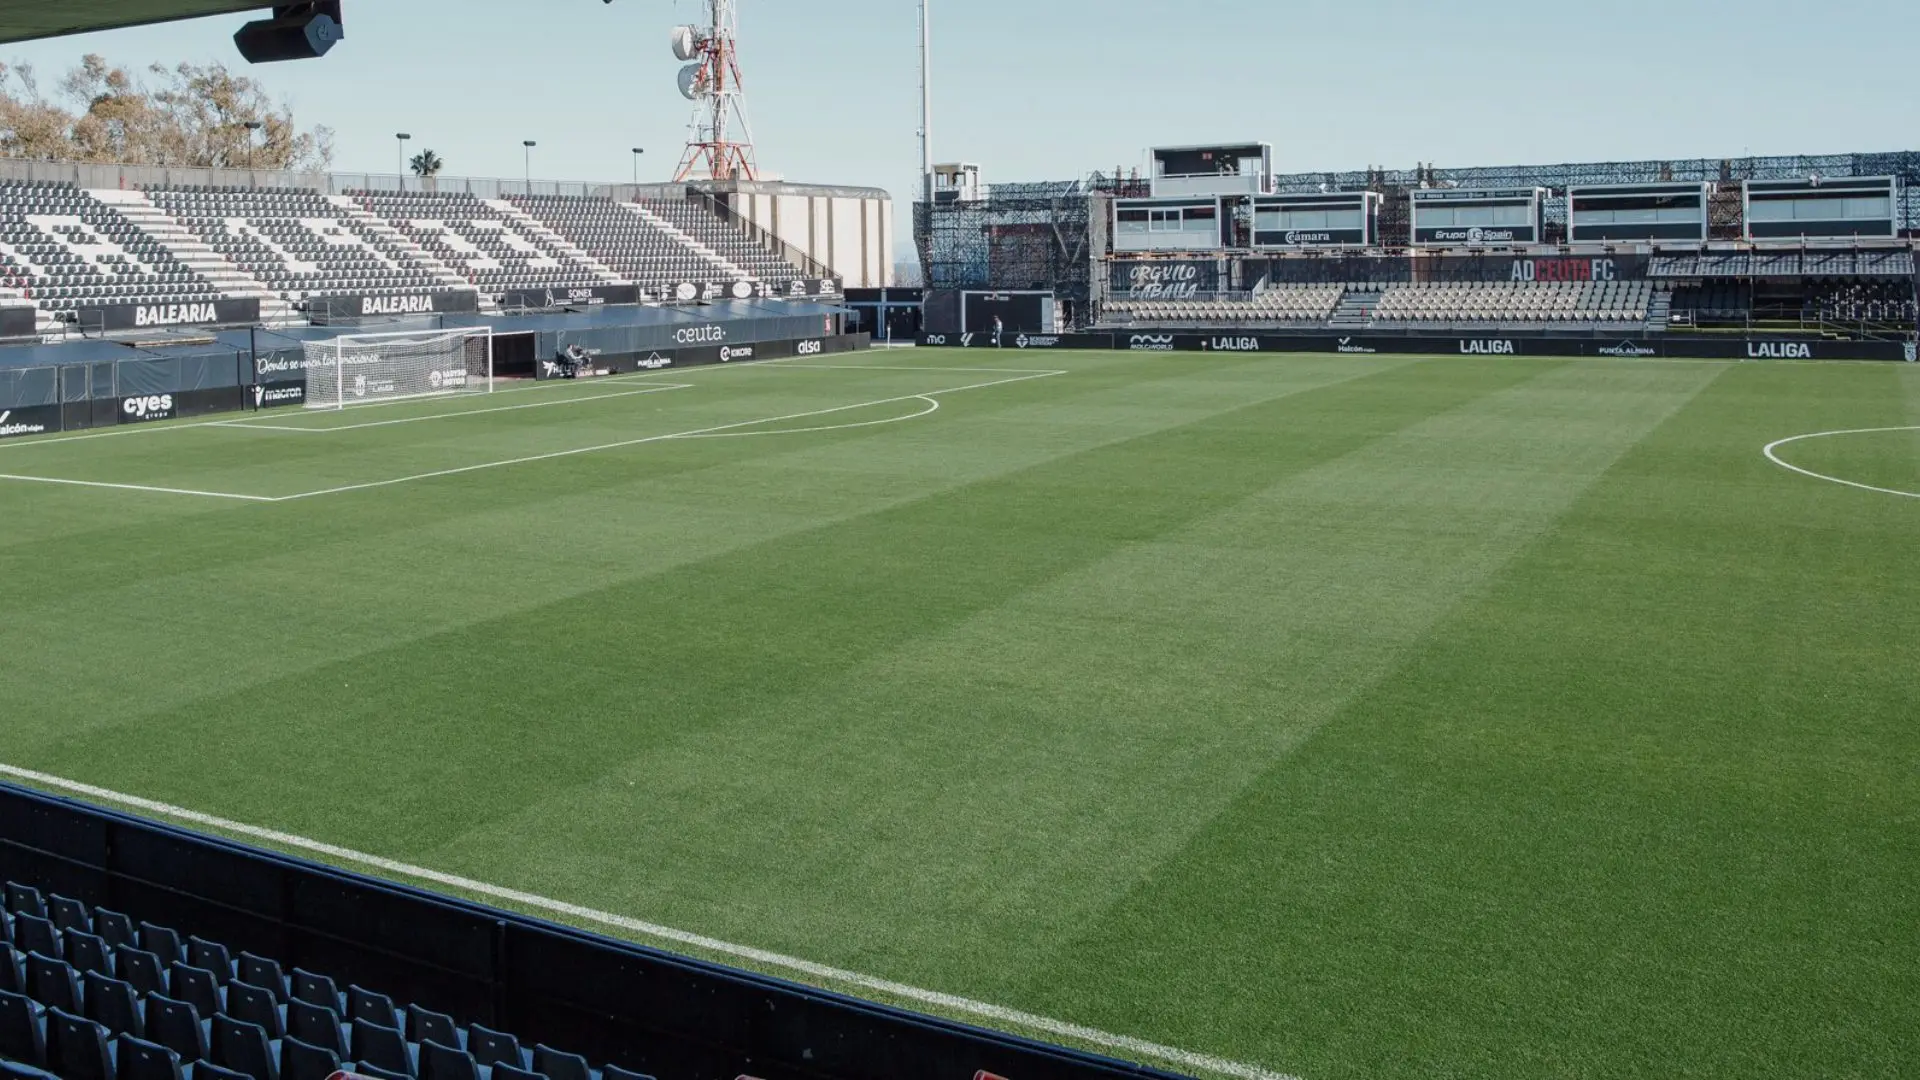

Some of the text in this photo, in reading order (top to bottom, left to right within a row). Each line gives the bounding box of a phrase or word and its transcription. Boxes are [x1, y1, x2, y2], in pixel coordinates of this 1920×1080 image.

[567, 288, 592, 298] SONEX
[797, 339, 821, 355] alsa
[1211, 336, 1259, 350] LALIGA
[1459, 339, 1514, 353] LALIGA
[1747, 342, 1811, 358] LALIGA
[265, 387, 302, 401] macron
[123, 394, 173, 417] cyes
[0, 422, 28, 435] alcón
